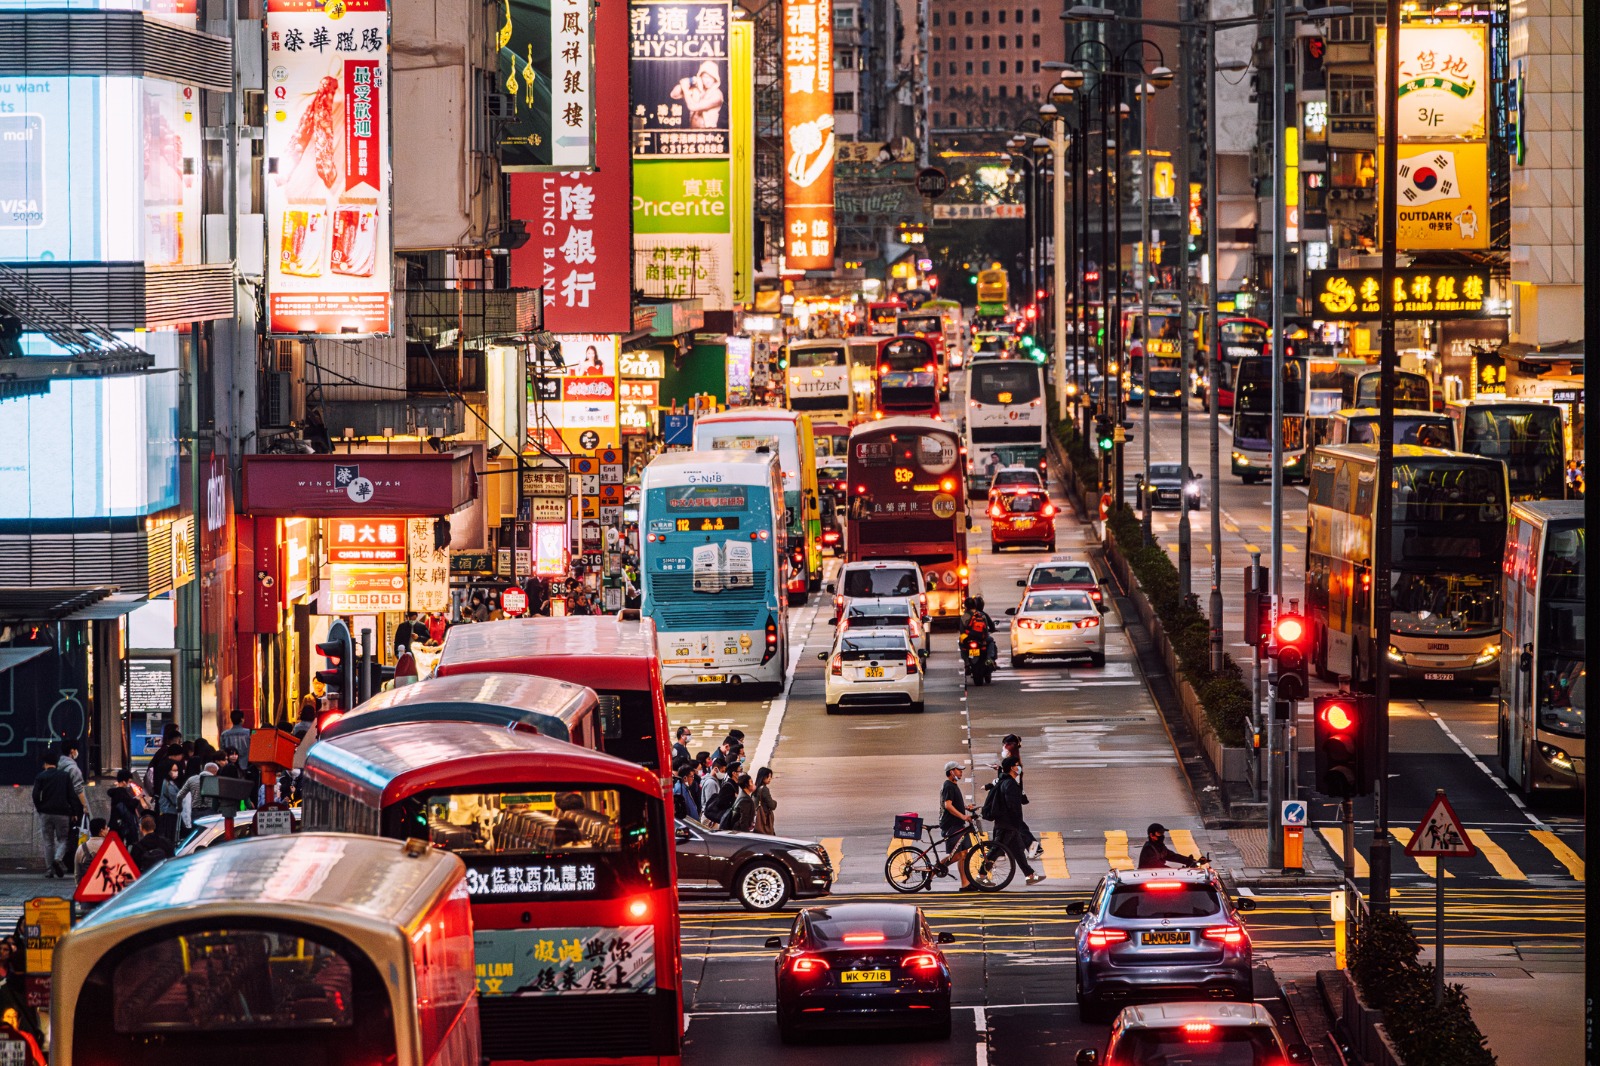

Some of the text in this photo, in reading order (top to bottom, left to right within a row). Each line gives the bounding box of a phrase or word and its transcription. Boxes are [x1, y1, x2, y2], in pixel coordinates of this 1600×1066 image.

[271, 31, 280, 51] 香港
[632, 40, 725, 56] HYSICAL
[787, 0, 816, 93] 福珠寶
[561, 0, 584, 128] 鳳祥銀樓
[818, 28, 829, 93] JEWELLERY
[16, 82, 50, 93] want
[354, 66, 371, 137] 最受歡迎
[658, 116, 682, 126] Yoga
[1418, 107, 1444, 126] 3/F
[4, 128, 33, 141] mall
[683, 178, 724, 197] 實惠
[2, 200, 37, 213] VISA
[1399, 212, 1452, 221] OUTDARK
[543, 178, 555, 307] LUNG BANK
[1362, 302, 1380, 312] LAO
[797, 382, 841, 393] CITIZEN
[895, 468, 914, 482] 93P
[356, 482, 371, 500] 華
[677, 520, 690, 531] 112
[581, 555, 602, 564] S16
[491, 865, 595, 884] 佐敦西九龍站
[491, 883, 519, 893] JORDAN
[543, 881, 576, 892] KOWLOON
[488, 963, 514, 977] LAM
[862, 972, 887, 980] 9718
